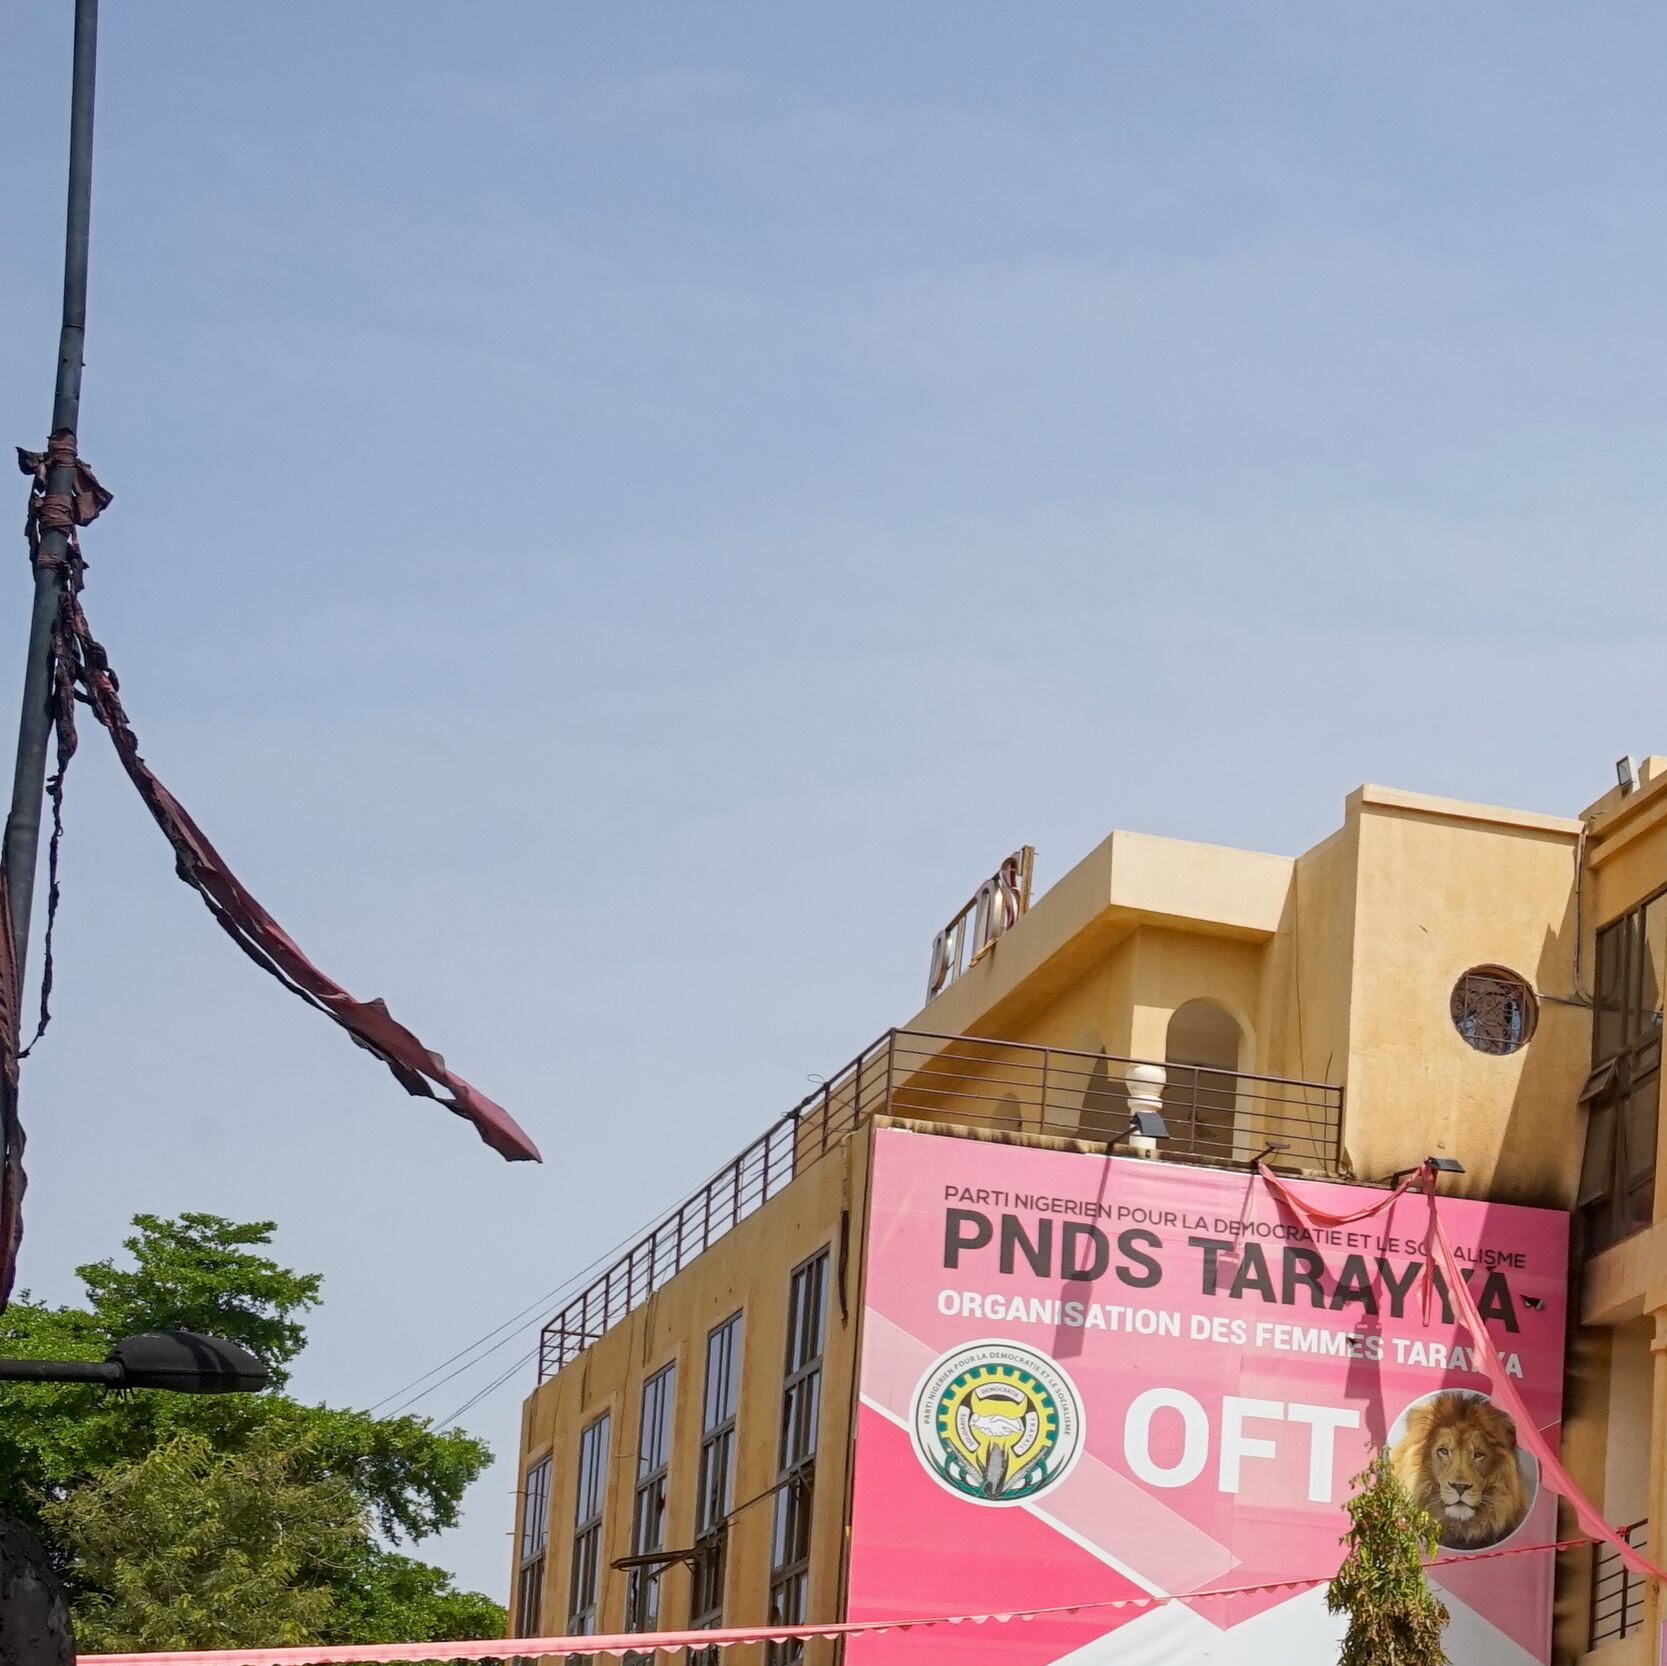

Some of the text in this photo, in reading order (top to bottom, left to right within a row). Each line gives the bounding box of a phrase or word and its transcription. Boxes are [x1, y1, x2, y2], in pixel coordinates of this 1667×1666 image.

[943, 1208, 1520, 1334] PNDS TARAYYA
[944, 1185, 1526, 1269] PARTI NIGERIEN POUR LA DEMOCRATIE ET LE SOALISME
[938, 1289, 1181, 1338] ORGANISATION
[1190, 1315, 1247, 1346] DES
[1256, 1322, 1384, 1362] FEMMES
[1123, 1387, 1361, 1504] OFT
